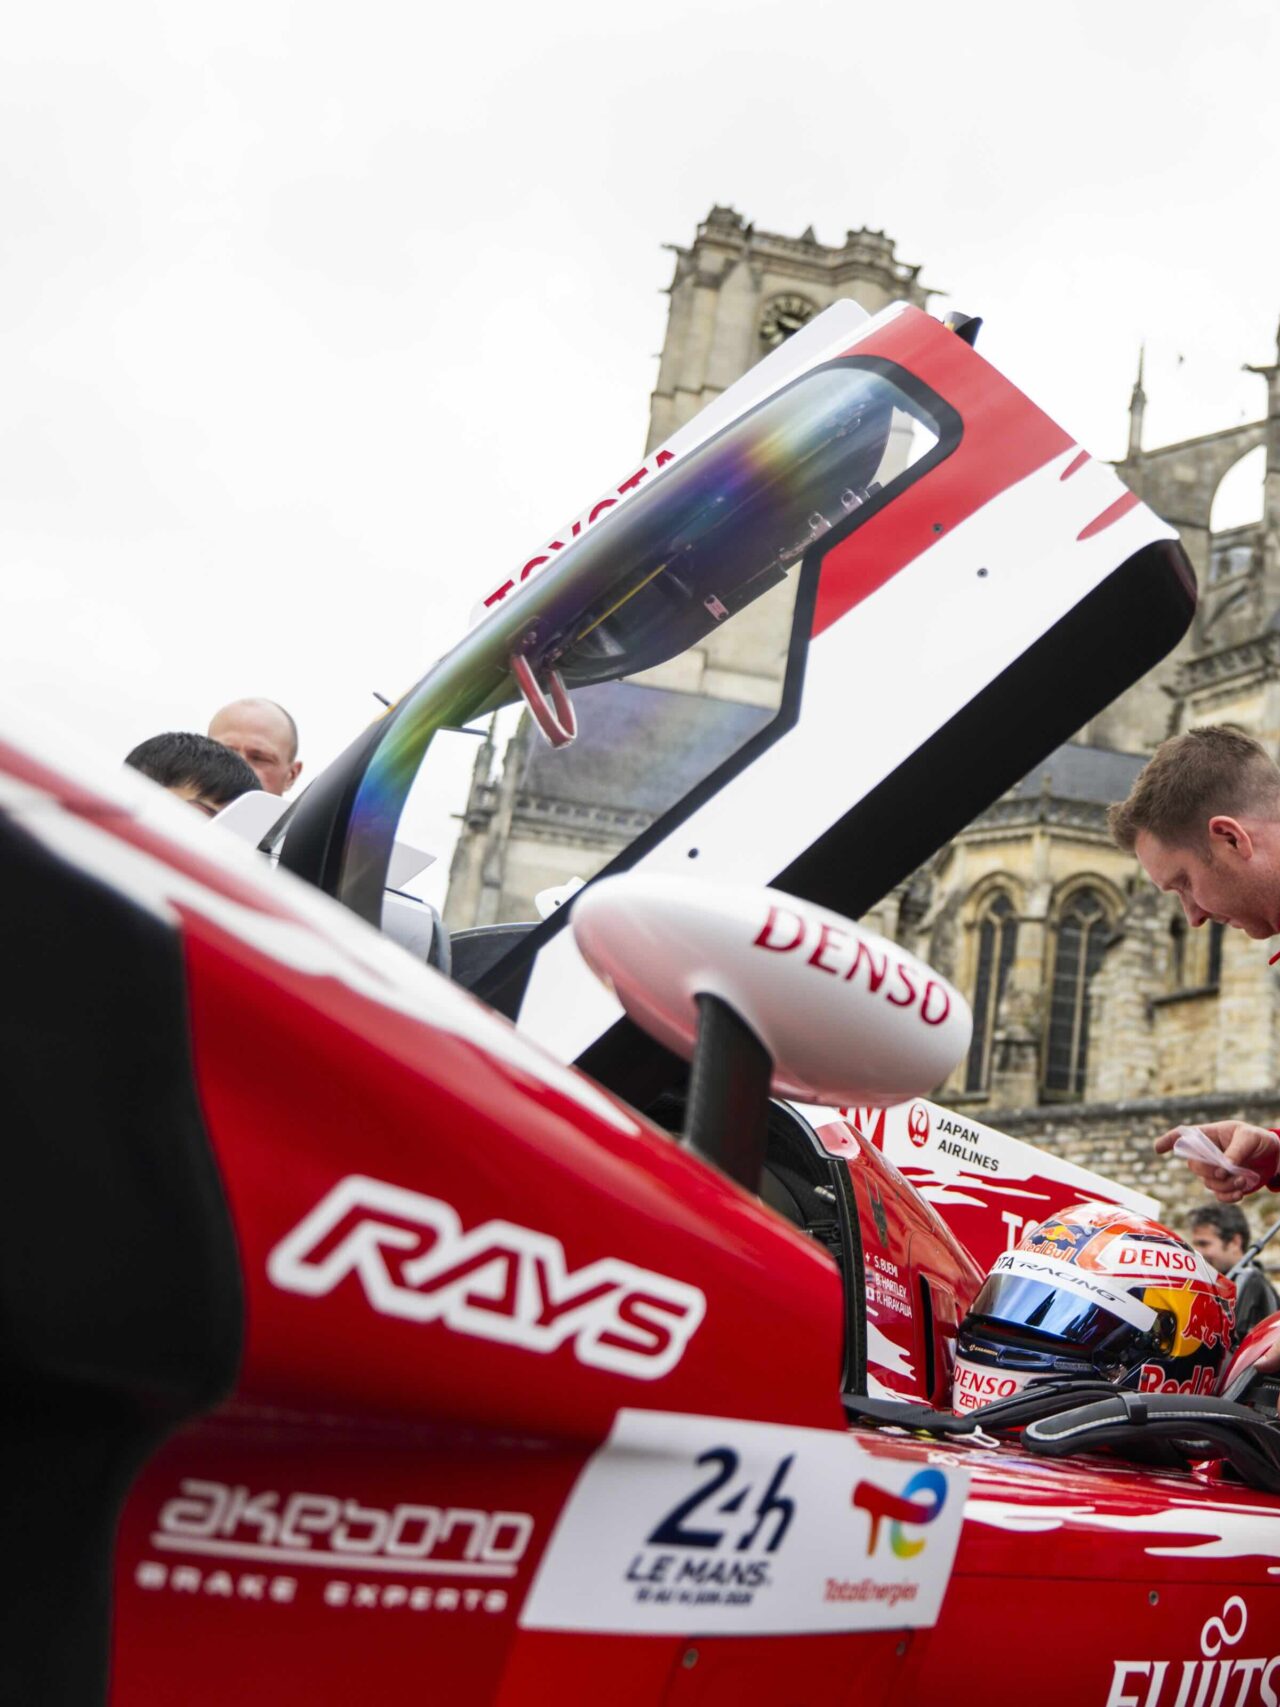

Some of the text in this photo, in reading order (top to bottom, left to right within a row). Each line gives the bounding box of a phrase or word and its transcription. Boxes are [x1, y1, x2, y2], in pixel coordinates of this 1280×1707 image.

[754, 905, 952, 1027] DENSO
[936, 1118, 980, 1145] JAPAN
[938, 1140, 1000, 1172] AIRLINES
[1118, 1247, 1197, 1272] DENSO
[267, 1174, 706, 1380] RAYS
[134, 1560, 509, 1614] BRAKE EXPERTS
[626, 1553, 769, 1587] LE MANS
